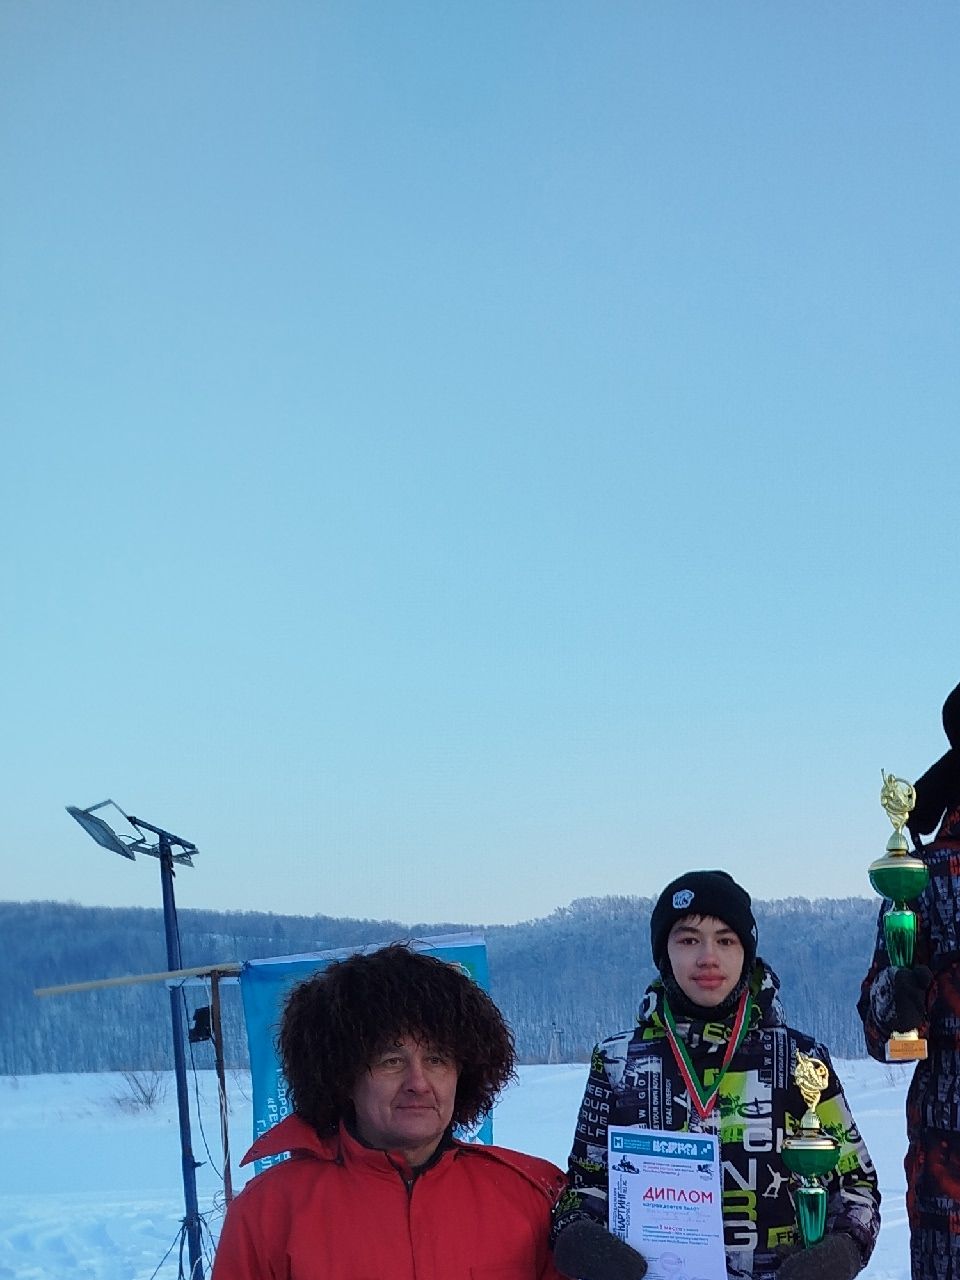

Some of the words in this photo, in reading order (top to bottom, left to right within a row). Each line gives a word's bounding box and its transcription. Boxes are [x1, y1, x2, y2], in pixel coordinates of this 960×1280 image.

[587, 1083, 613, 1100] EET
[583, 1097, 610, 1114] OUR
[581, 1110, 608, 1127] RUE
[643, 1187, 713, 1204] ДИПЛОМ
